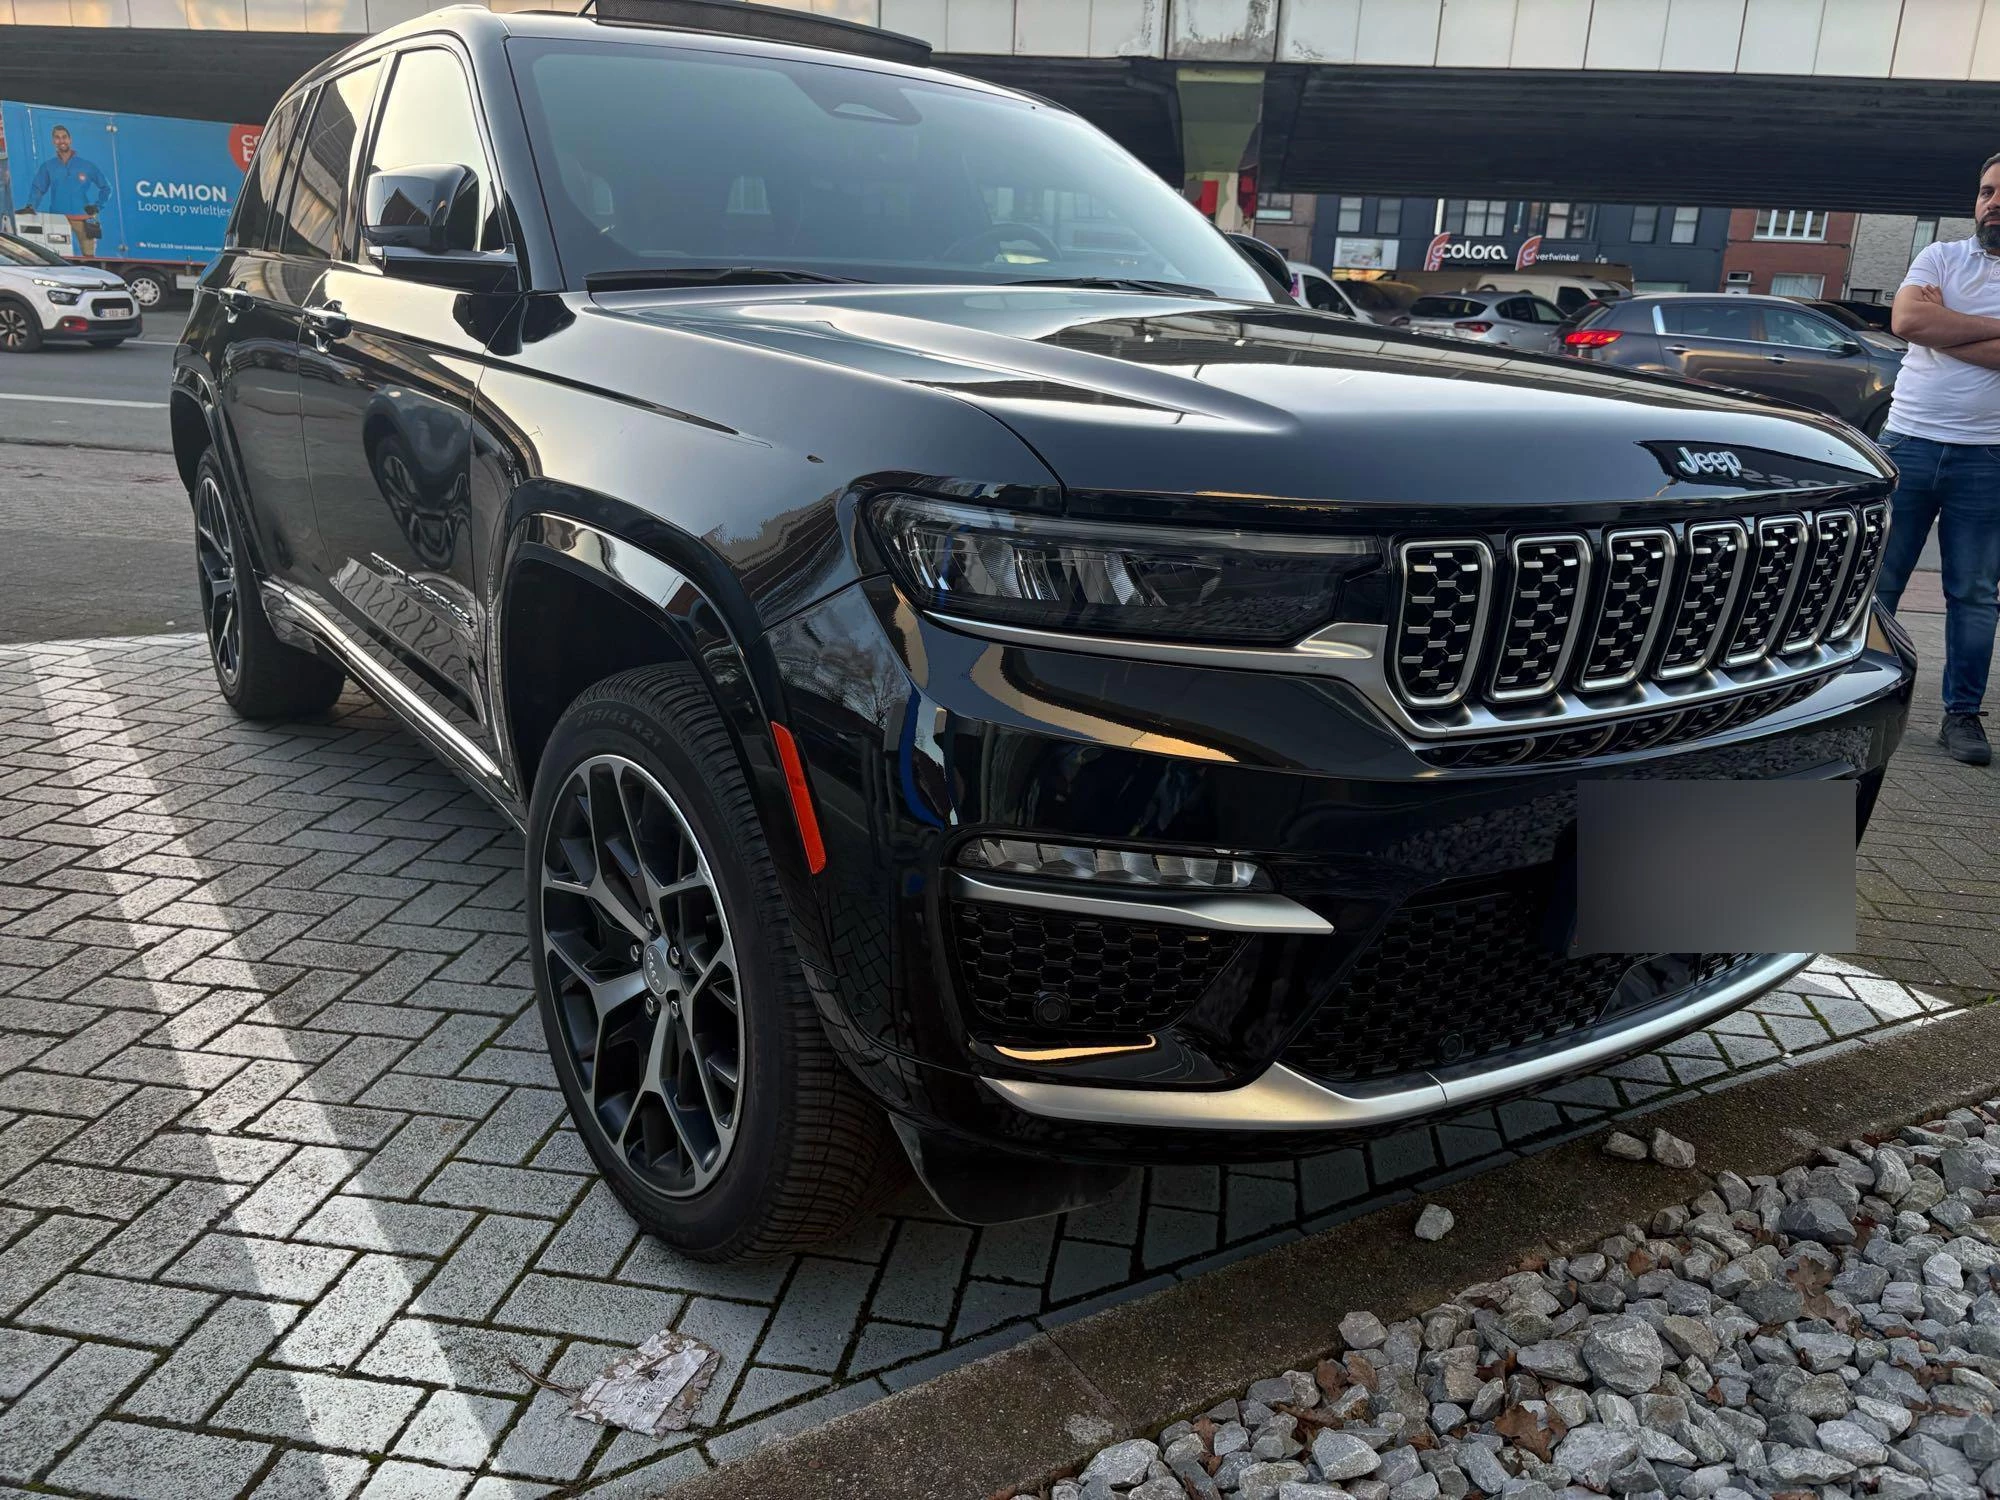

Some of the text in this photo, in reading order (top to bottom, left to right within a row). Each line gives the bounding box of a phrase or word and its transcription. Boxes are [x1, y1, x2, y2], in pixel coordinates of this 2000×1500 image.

[138, 201, 171, 215] Loopt
[173, 204, 187, 217] op
[1442, 240, 1508, 260] colora
[1677, 446, 1743, 478] Jeep
